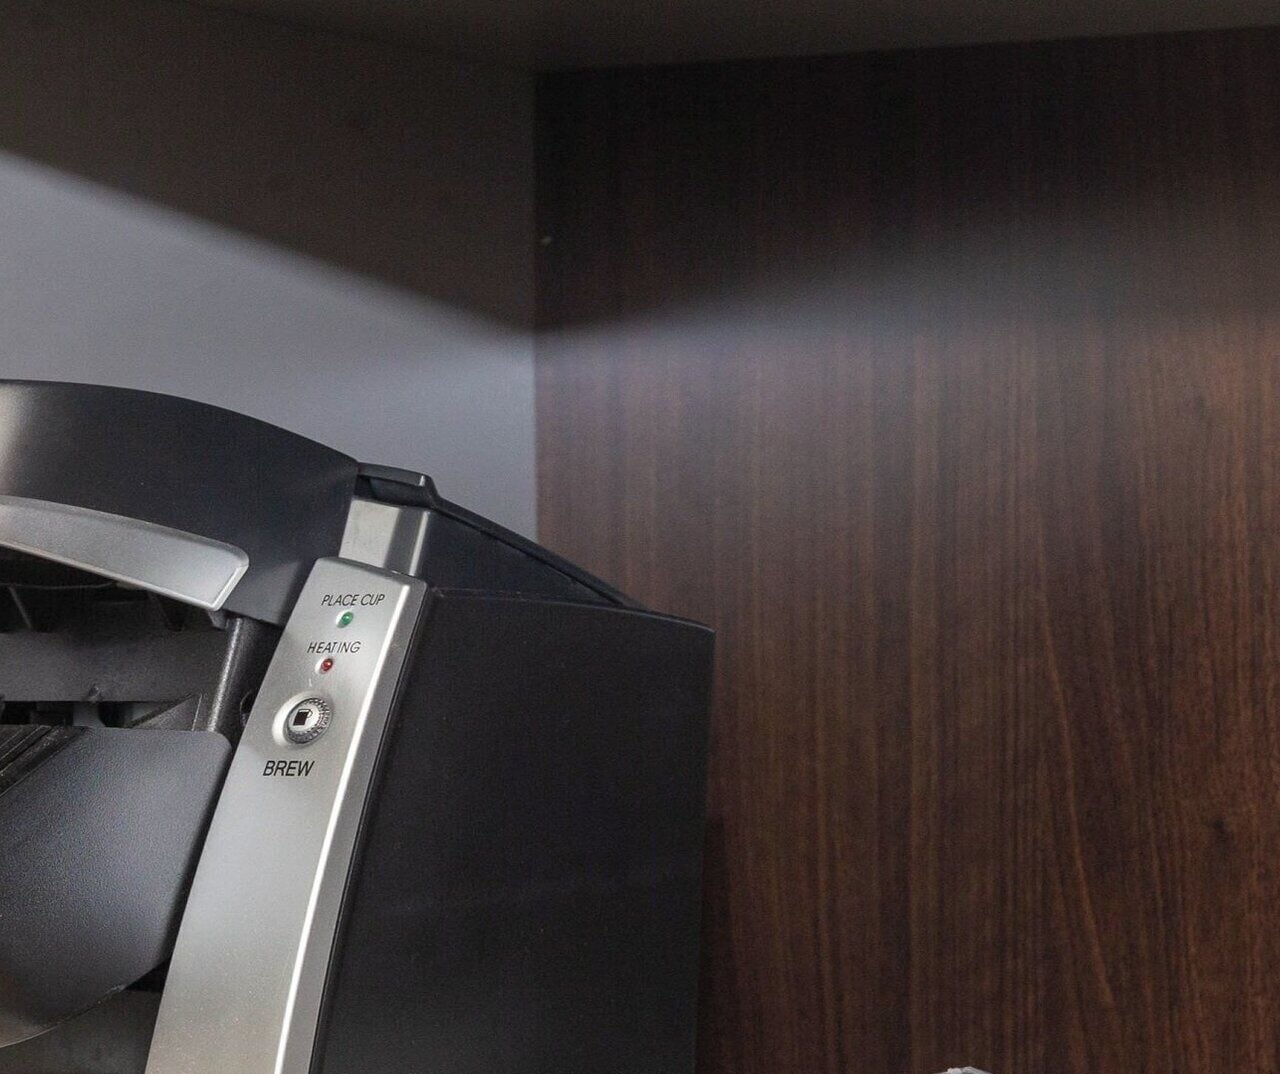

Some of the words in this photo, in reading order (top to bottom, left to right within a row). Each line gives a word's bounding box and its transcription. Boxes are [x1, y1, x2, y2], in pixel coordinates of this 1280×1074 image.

[320, 594, 359, 607] PLACE
[360, 593, 386, 606] CUP
[306, 641, 362, 654] HEATING
[262, 760, 315, 777] BREW
